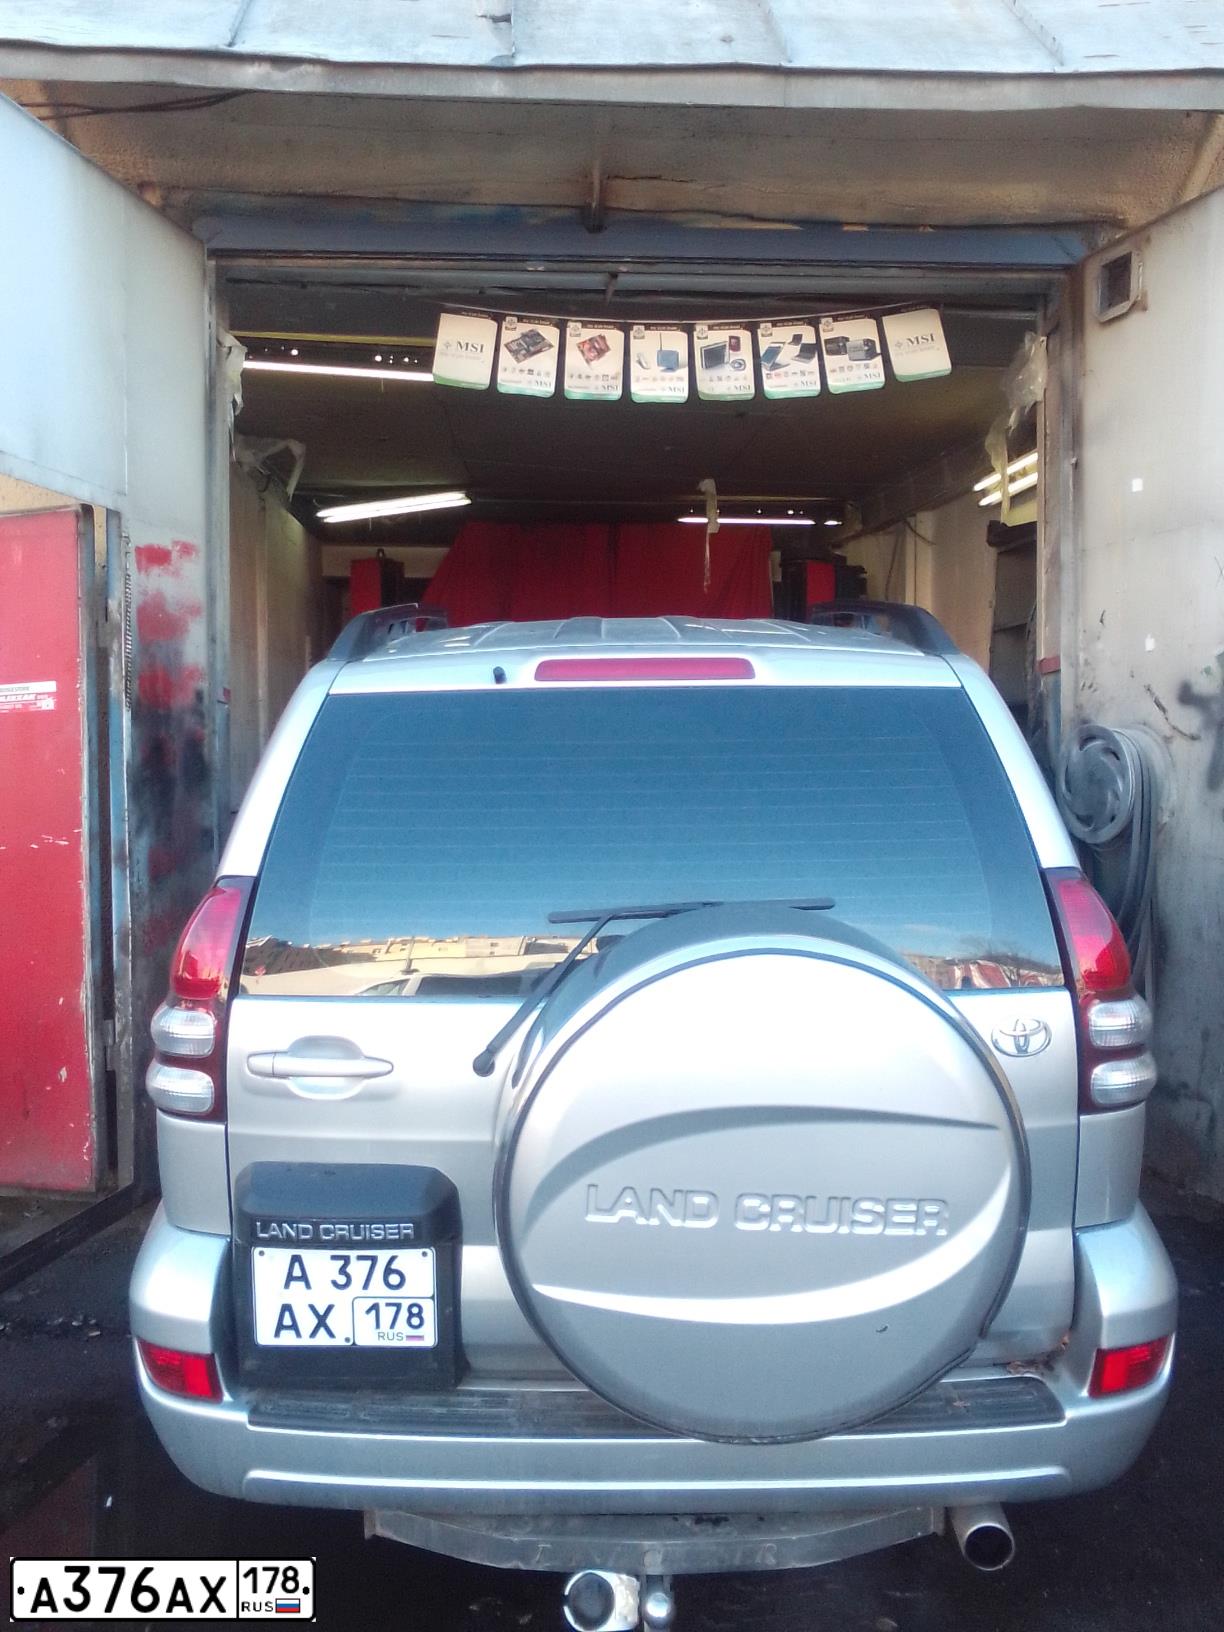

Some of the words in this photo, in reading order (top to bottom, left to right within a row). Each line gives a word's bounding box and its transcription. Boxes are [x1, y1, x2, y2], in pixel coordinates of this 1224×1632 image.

[906, 333, 935, 346] MSI
[456, 341, 485, 353] MSI
[864, 372, 881, 380] MSI
[535, 380, 552, 388] MSI
[602, 384, 619, 392] MSI
[585, 1183, 720, 1229] LAND
[734, 1192, 951, 1236] CRUISER
[256, 1221, 313, 1240] LAND
[319, 1223, 415, 1241] CRUISER
[330, 1254, 406, 1291] 376
[365, 1302, 425, 1330] 178
[377, 1331, 404, 1342] RUS
